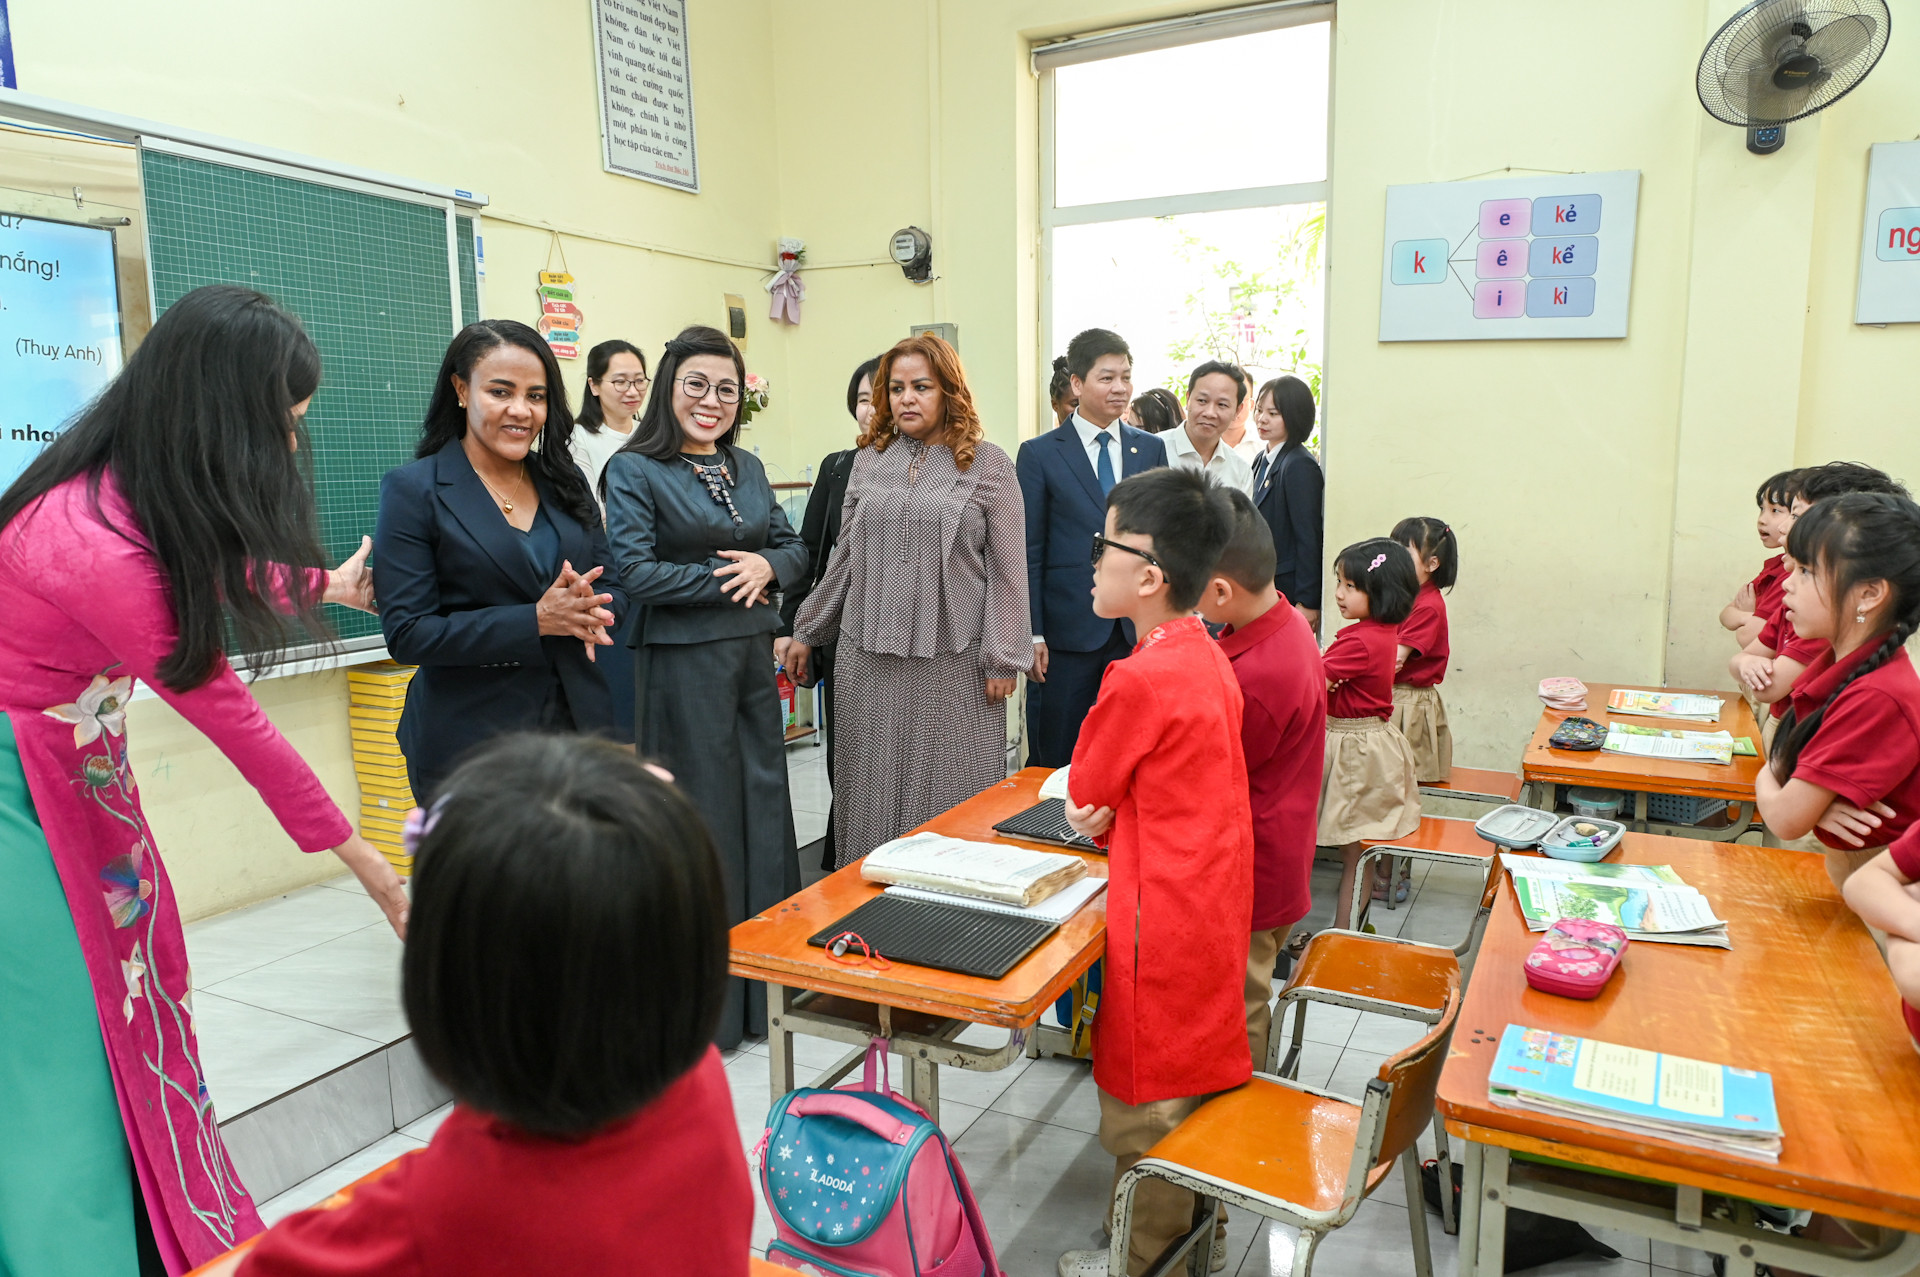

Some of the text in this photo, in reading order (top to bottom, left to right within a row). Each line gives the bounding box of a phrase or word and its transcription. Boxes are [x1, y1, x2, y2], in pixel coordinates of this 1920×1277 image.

[662, 4, 678, 18] Nam
[635, 25, 647, 38] dân
[668, 38, 680, 51] Việt
[654, 17, 666, 30] đẹp
[668, 22, 679, 36] hay
[606, 30, 681, 67] Nam có bước tới đài
[608, 49, 682, 83] vinh quang để sánh vai
[609, 67, 684, 99] với các cường quốc
[612, 100, 635, 117] không,
[640, 110, 658, 123] chính
[663, 116, 669, 126] là
[632, 91, 648, 103] châu
[653, 97, 668, 111] được
[673, 104, 684, 117] hay
[613, 120, 626, 131] một
[651, 129, 661, 140] lớn
[672, 137, 687, 149] công
[614, 134, 626, 147] học
[628, 139, 638, 151] tập
[640, 142, 651, 153] của
[652, 146, 663, 156] các
[1500, 204, 1577, 226] e kẻ
[0, 251, 59, 280] nắng!
[1414, 245, 1575, 274] k ê kể
[1497, 287, 1568, 306] i kì
[64, 345, 101, 366] Anh)
[12, 424, 60, 442] nha
[809, 1168, 853, 1194] LADODA
